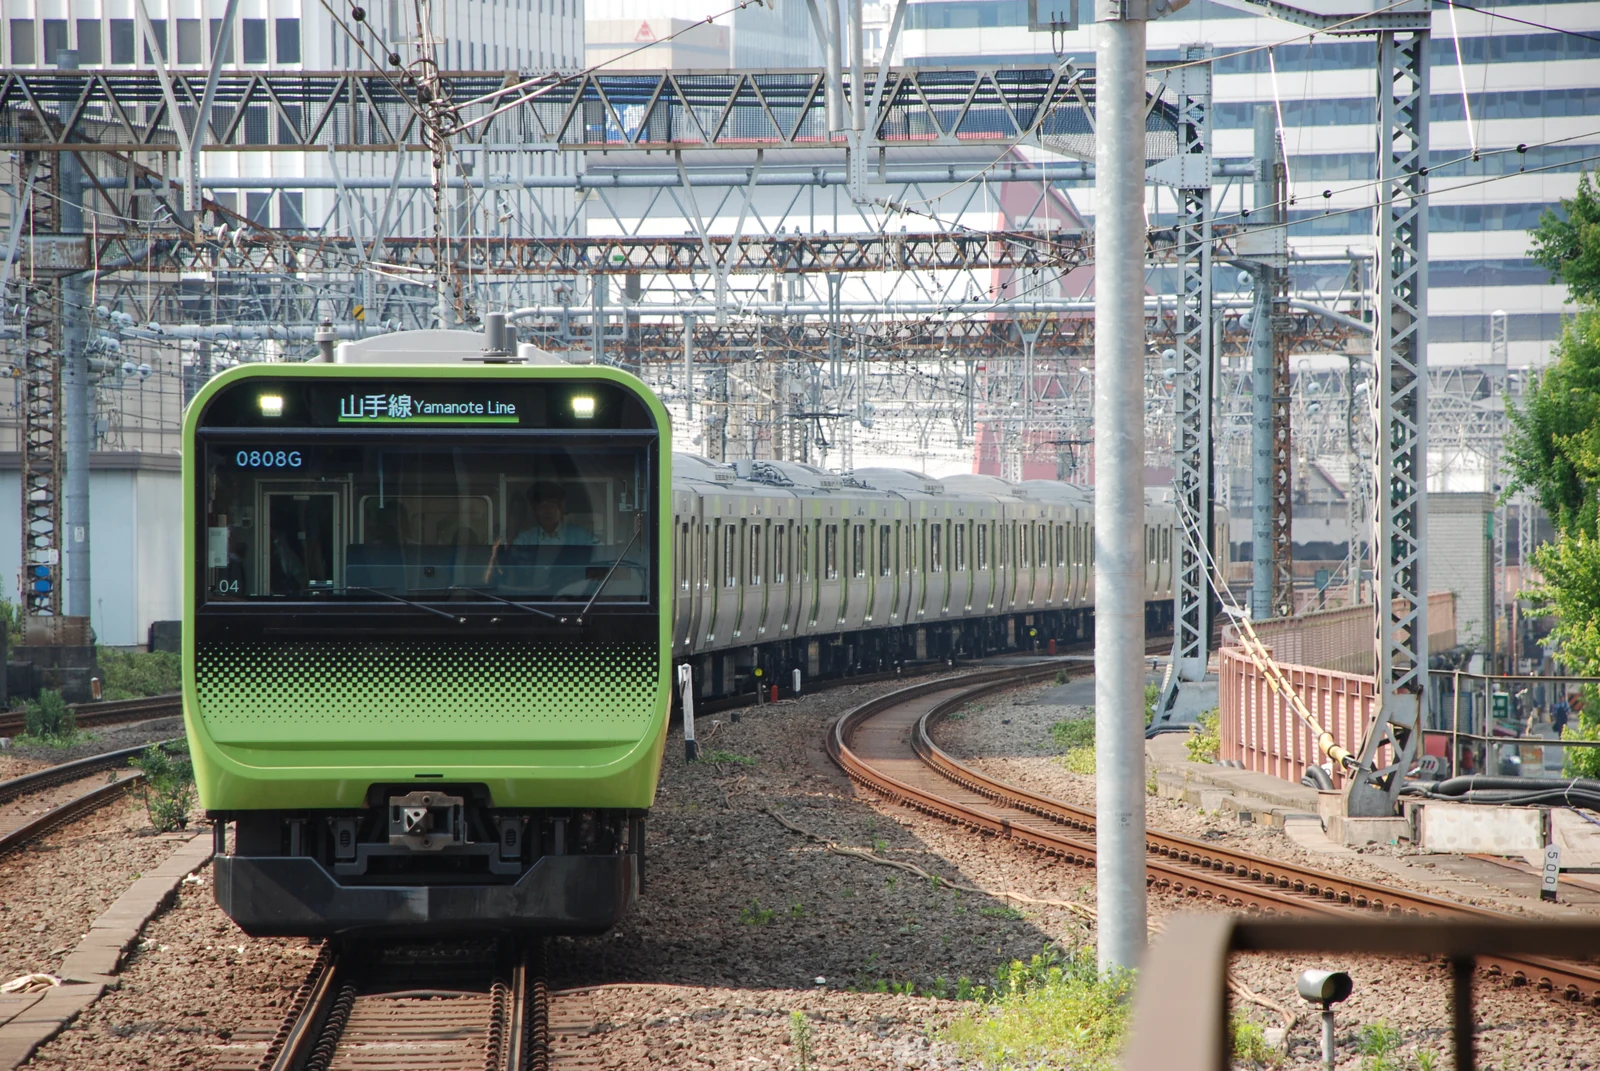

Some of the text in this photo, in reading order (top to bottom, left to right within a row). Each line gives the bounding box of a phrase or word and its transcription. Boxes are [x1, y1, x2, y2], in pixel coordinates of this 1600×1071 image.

[340, 394, 516, 418] 山手線 Yamanote Line
[236, 450, 302, 467] 0808G
[219, 579, 239, 593] 04
[1545, 851, 1558, 884] 500
